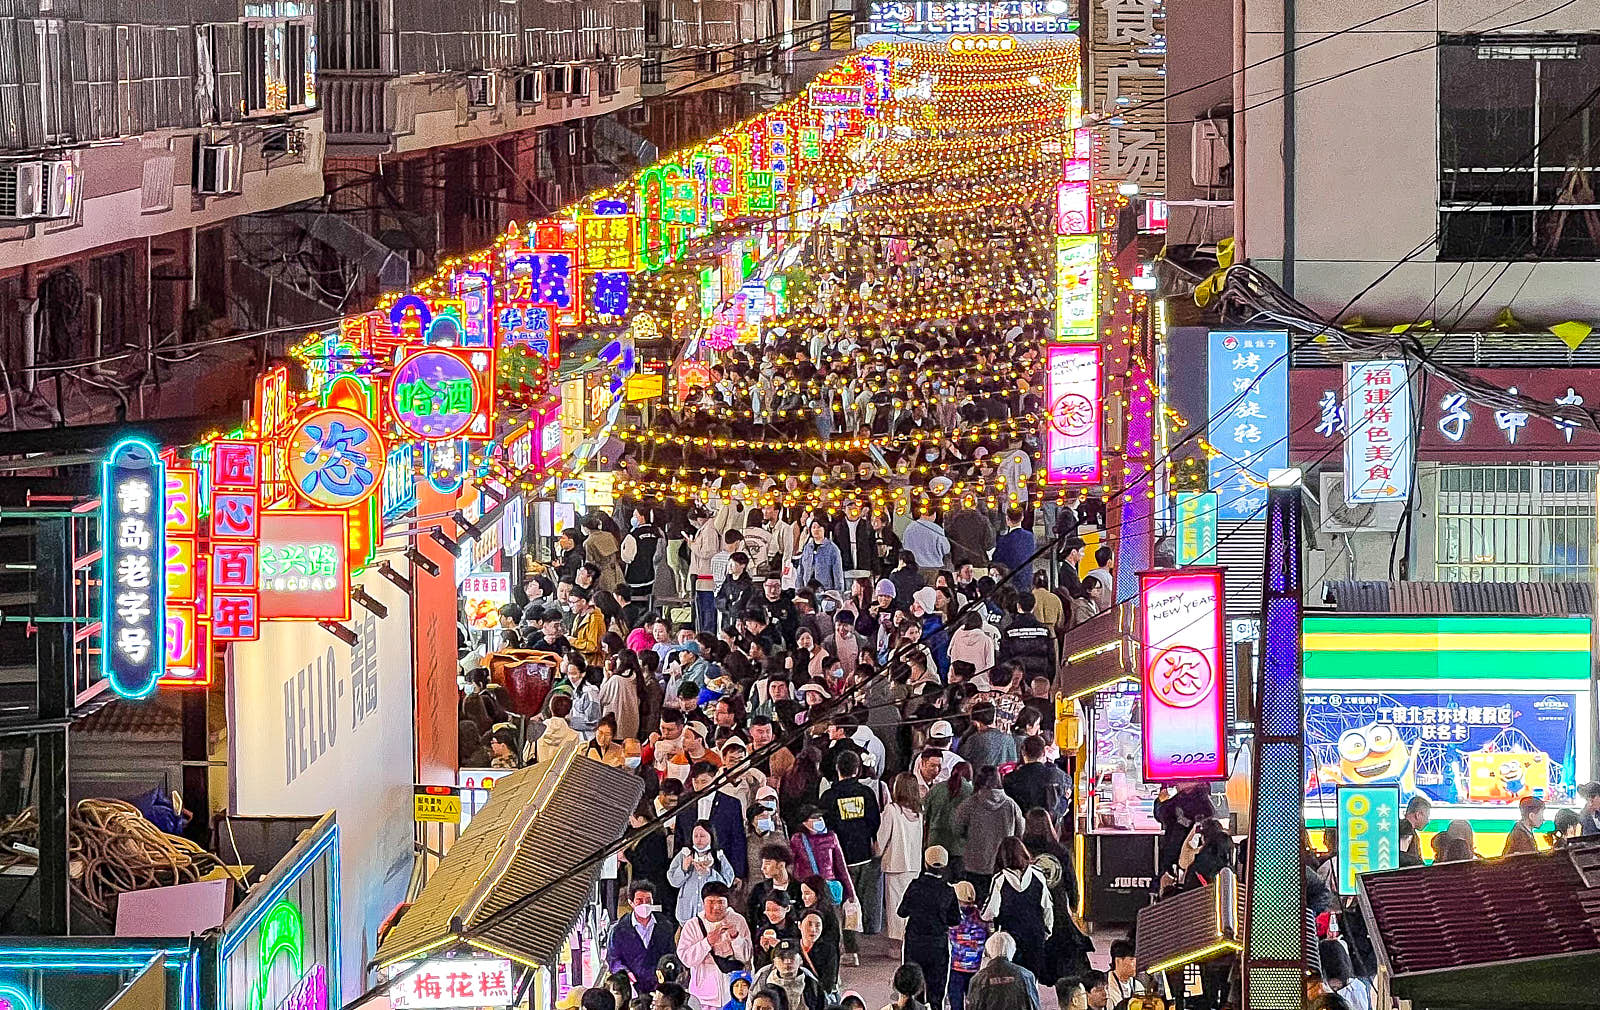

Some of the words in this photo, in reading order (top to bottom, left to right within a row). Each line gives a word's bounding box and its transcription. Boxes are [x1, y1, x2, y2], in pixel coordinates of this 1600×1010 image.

[999, 18, 1070, 32] STREET
[1103, 0, 1156, 183] 食广场
[397, 376, 474, 417] 哈酒
[1363, 368, 1393, 481] 福建特色美食
[302, 420, 376, 497] 恣
[214, 446, 253, 632] 匠心百年
[1182, 498, 1199, 561] OPEN
[116, 480, 152, 664] 青岛老字号
[261, 576, 337, 592] INGDAO
[1146, 592, 1185, 612] HAPPY
[1153, 606, 1181, 622] NEW
[1183, 594, 1217, 614] YEAR
[1377, 707, 1513, 725] 工银北京环球度假区
[1421, 725, 1468, 741] 联名卡
[1170, 752, 1217, 765] 2023
[413, 970, 509, 1000] 梅花糕
